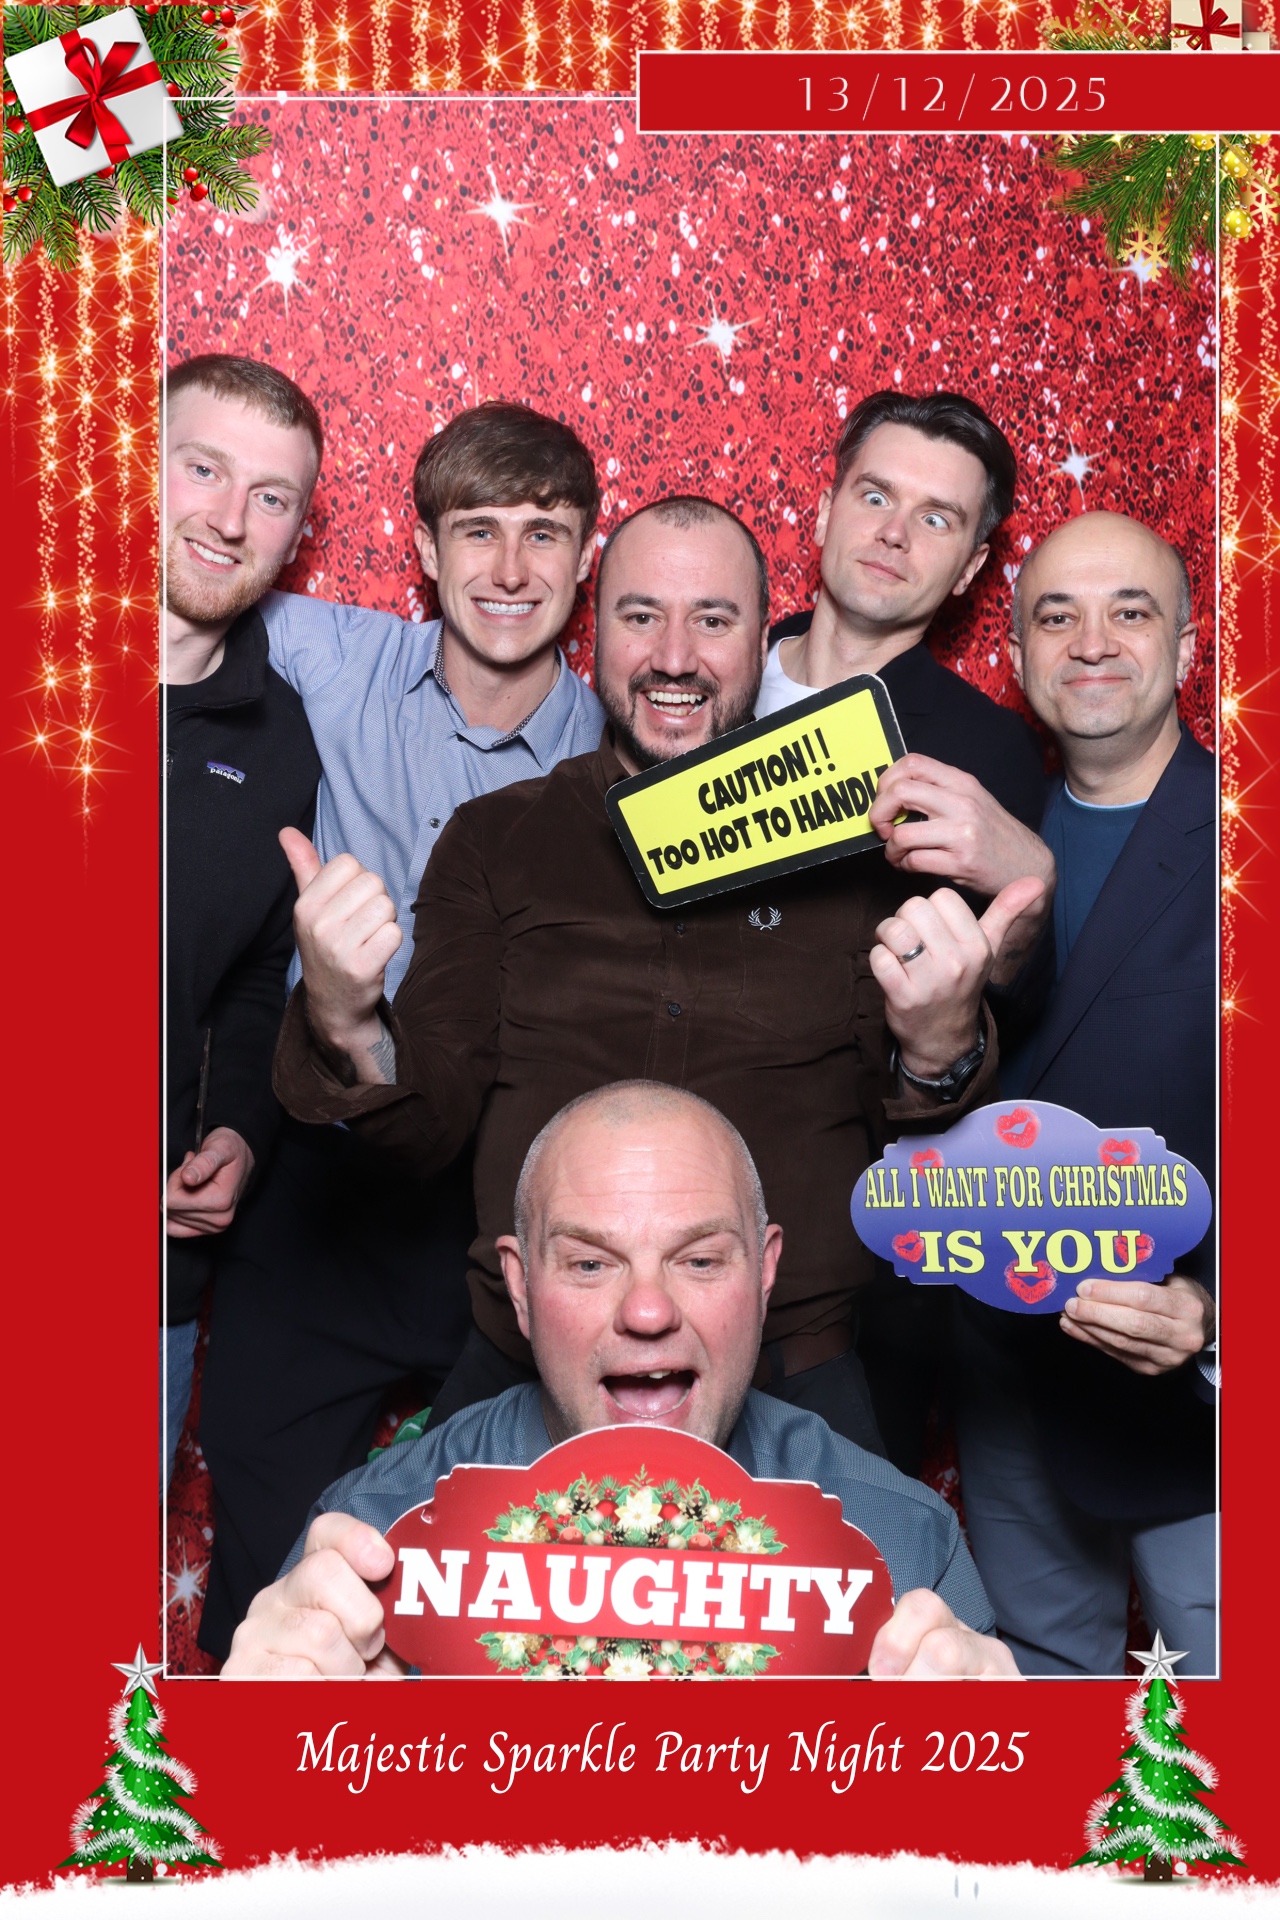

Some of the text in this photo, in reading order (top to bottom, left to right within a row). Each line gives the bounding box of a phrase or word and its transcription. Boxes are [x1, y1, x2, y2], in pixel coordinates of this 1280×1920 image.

[698, 727, 836, 815] CAUTION!!
[646, 764, 889, 875] TOO HOT TO HANDL
[865, 1163, 1188, 1208] ALL I WANT FOR CHRISTMAS
[919, 1229, 1141, 1274] IS YOU
[394, 1548, 873, 1635] NAUGHTY
